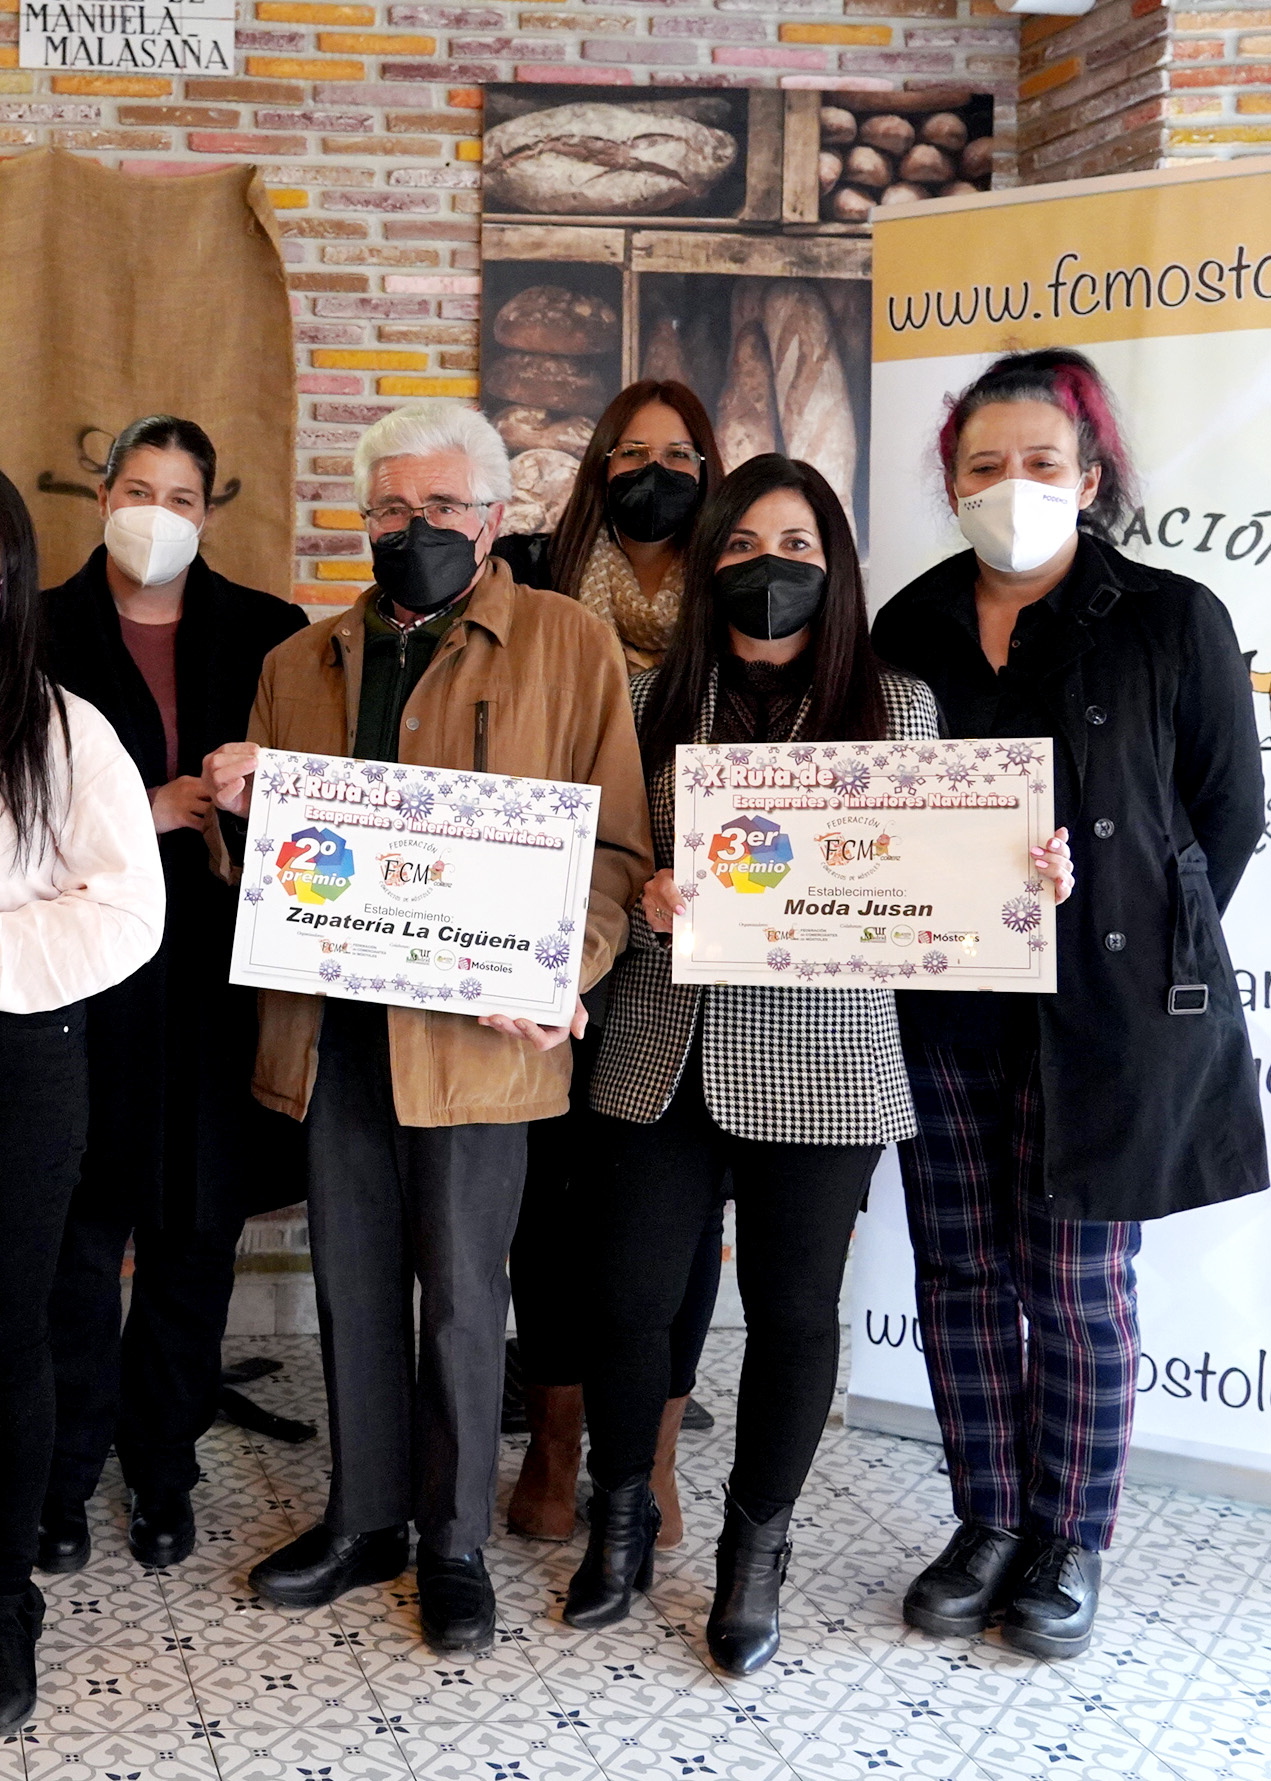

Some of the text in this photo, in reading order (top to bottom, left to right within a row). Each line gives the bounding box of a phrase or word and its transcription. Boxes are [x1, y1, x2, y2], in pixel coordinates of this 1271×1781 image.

[26, 4, 180, 35] MANUELA
[44, 34, 229, 70] MALASAÑA
[704, 763, 836, 789] X Ruta de
[278, 771, 403, 809] X Ruta de
[733, 792, 1018, 811] Escaparates e Interiores Navideños
[304, 805, 564, 849] Escaparates e Interiores Navideños
[827, 816, 880, 829] FEDERACIÓN
[389, 840, 438, 854] FEDERACIÓN
[718, 827, 779, 861] 3er
[824, 839, 874, 861] FCM
[384, 860, 429, 884] FCM
[716, 860, 785, 875] premio
[281, 870, 346, 888] premio
[808, 886, 907, 897] Establecimiento:
[364, 904, 454, 924] Establecimiento:
[784, 899, 933, 918] Moda Jusan
[286, 907, 530, 952] Zapatería La Cigüeña
[933, 933, 980, 942] Móstos
[471, 961, 513, 974] Móstoles
